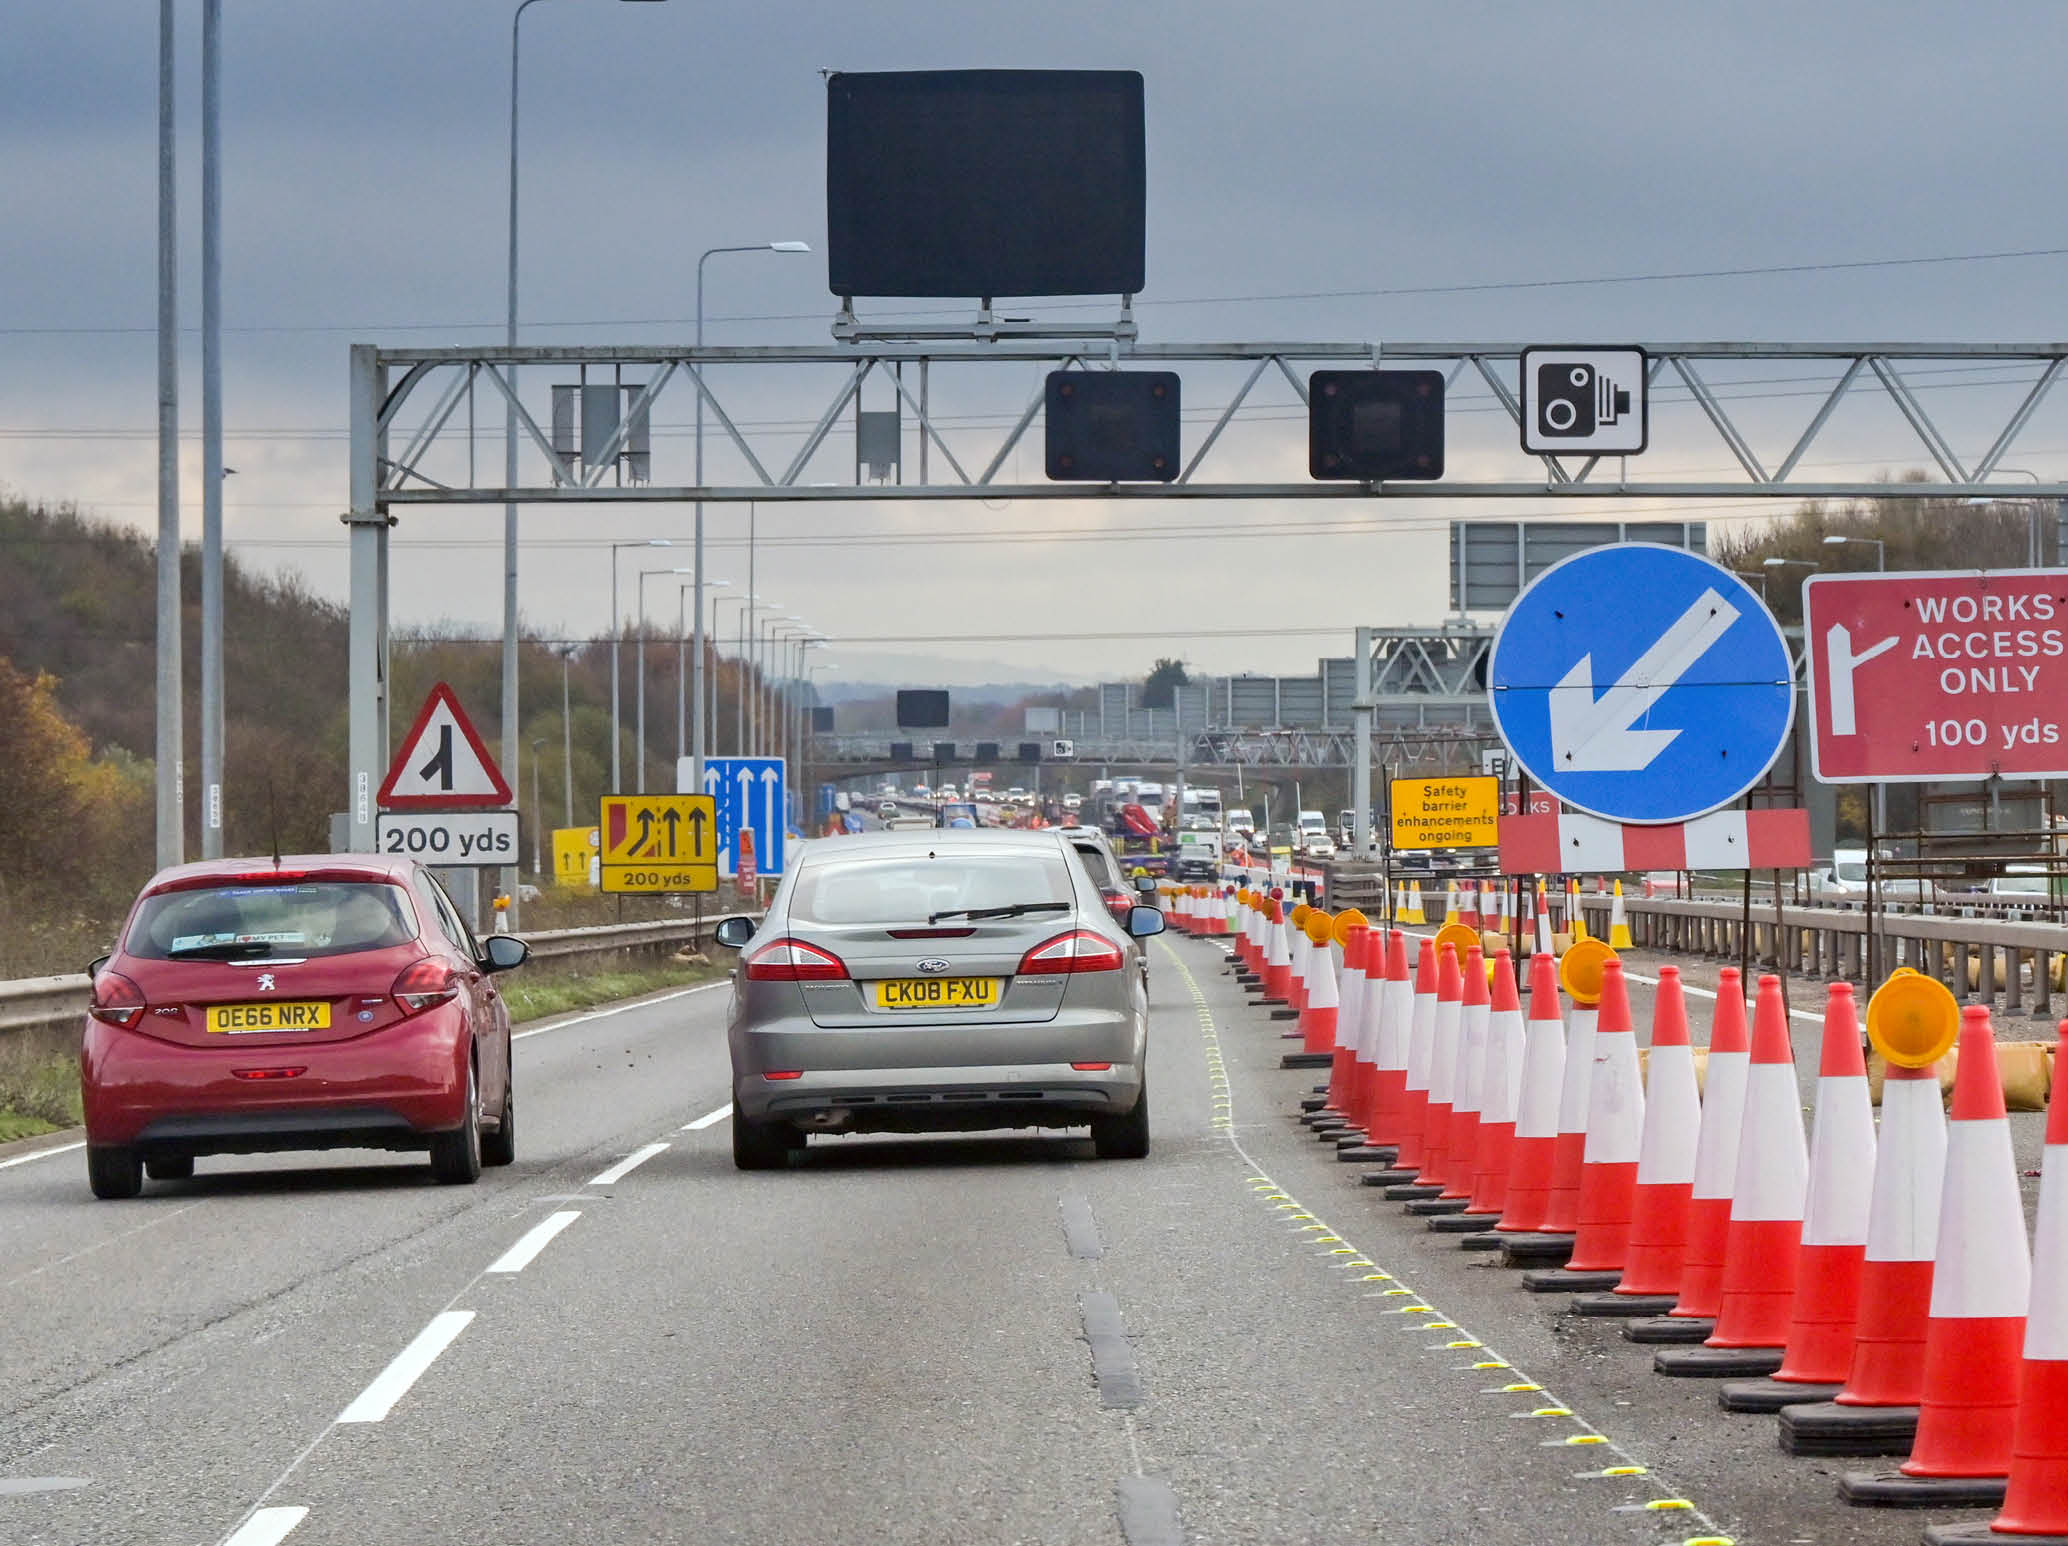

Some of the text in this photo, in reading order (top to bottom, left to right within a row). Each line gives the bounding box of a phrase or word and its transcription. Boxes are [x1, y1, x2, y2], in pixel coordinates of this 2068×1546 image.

[1915, 594, 2055, 623] WORKS
[1912, 630, 2064, 659] ACCESS
[1940, 666, 2040, 694] ONLY
[1925, 717, 2060, 750] 100 yds
[1423, 785, 1467, 799] Safety
[1422, 801, 1467, 812] barrier
[1397, 814, 1494, 827] enhancements
[386, 827, 510, 857] 200 yds
[1419, 832, 1472, 843] ongoing
[624, 872, 691, 887] 200 yds
[885, 980, 989, 1002] CK08 FXU
[217, 1006, 320, 1028] OE66 NRX
